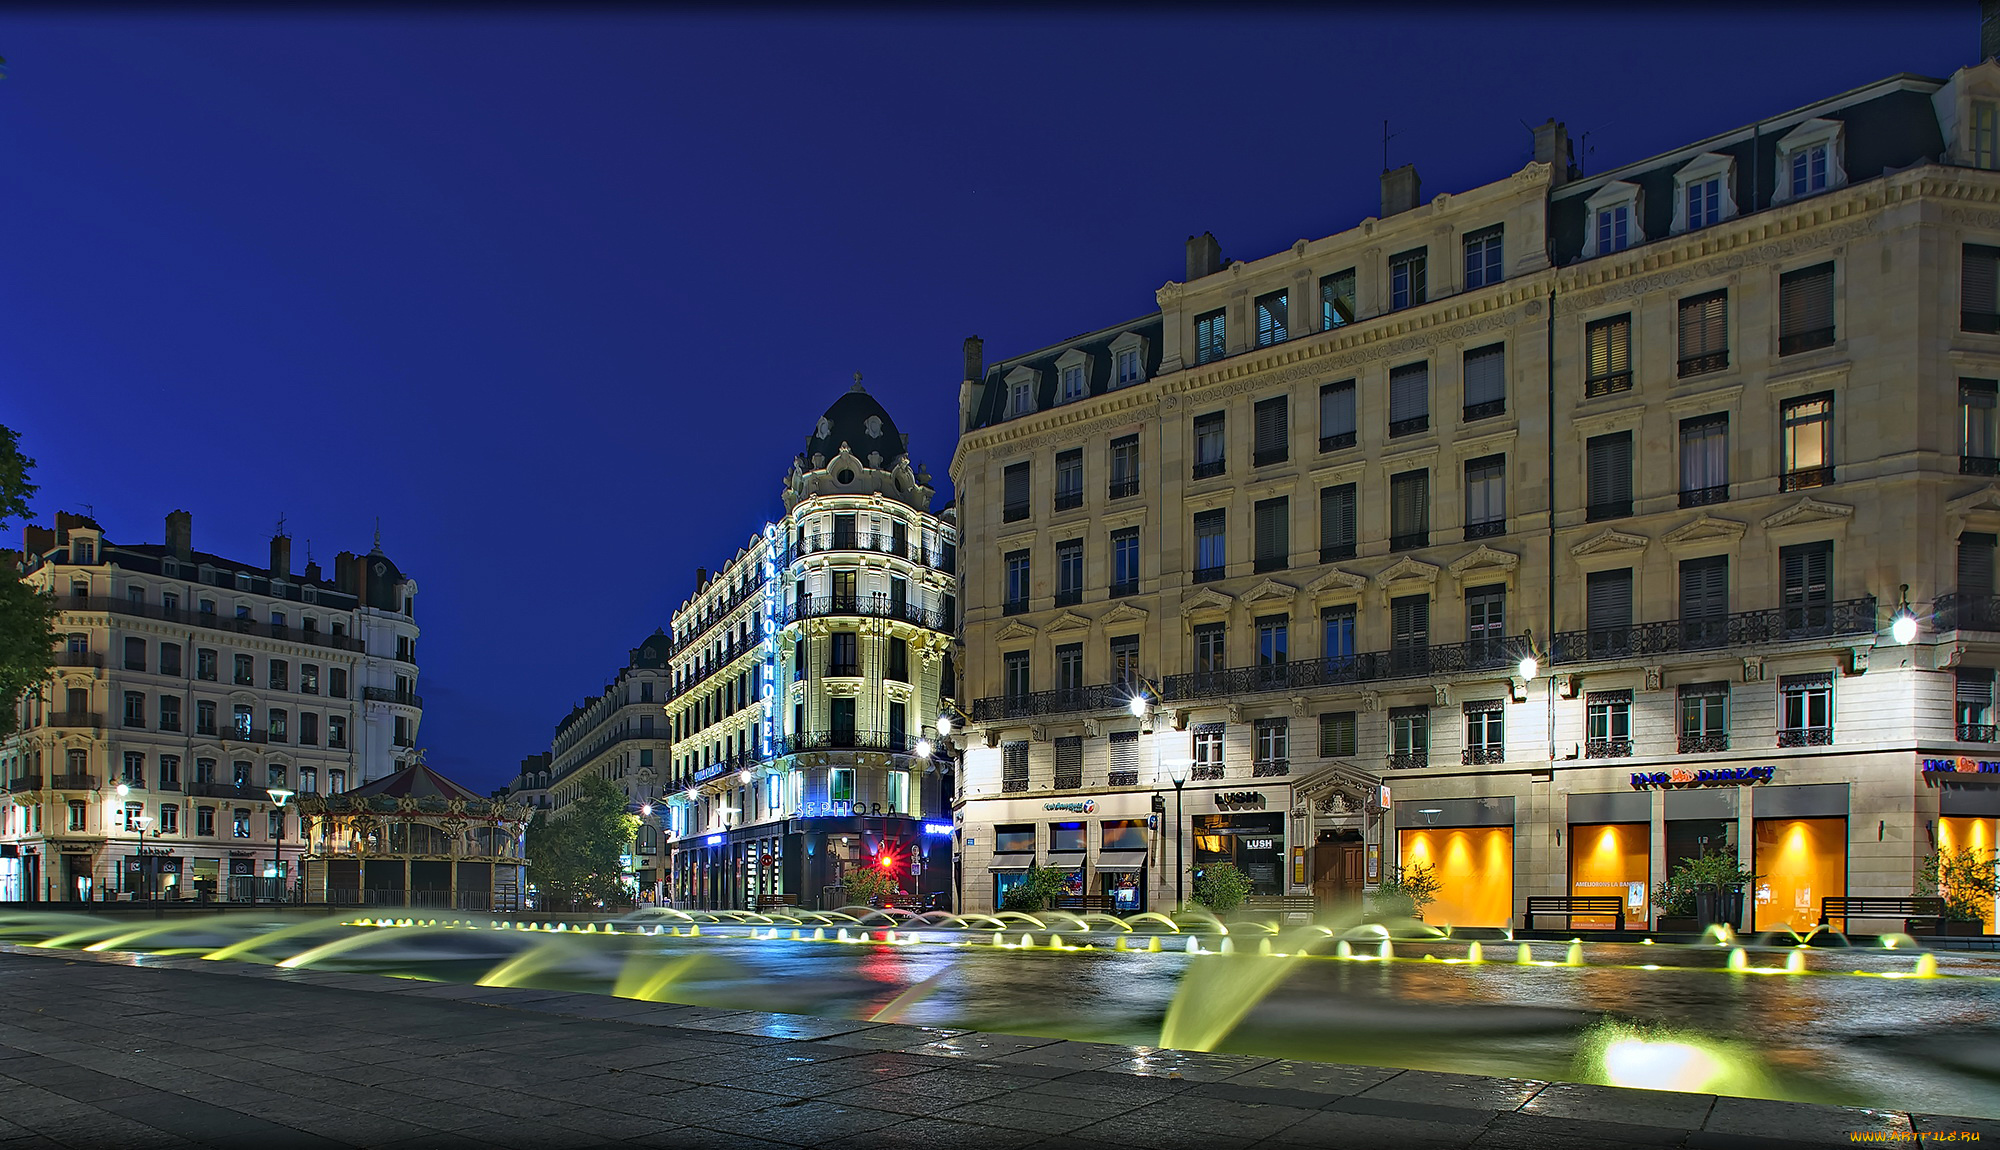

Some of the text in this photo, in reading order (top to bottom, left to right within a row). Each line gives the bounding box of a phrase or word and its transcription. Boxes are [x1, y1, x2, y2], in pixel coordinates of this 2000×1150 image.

[763, 525, 776, 756] CARLTON HOTEL
[1923, 758, 1956, 773] ING
[1630, 765, 1776, 785] ING DIRECT
[1215, 791, 1258, 804] LUSH
[797, 801, 897, 817] SEPHORA
[1247, 839, 1272, 848] LUSH
